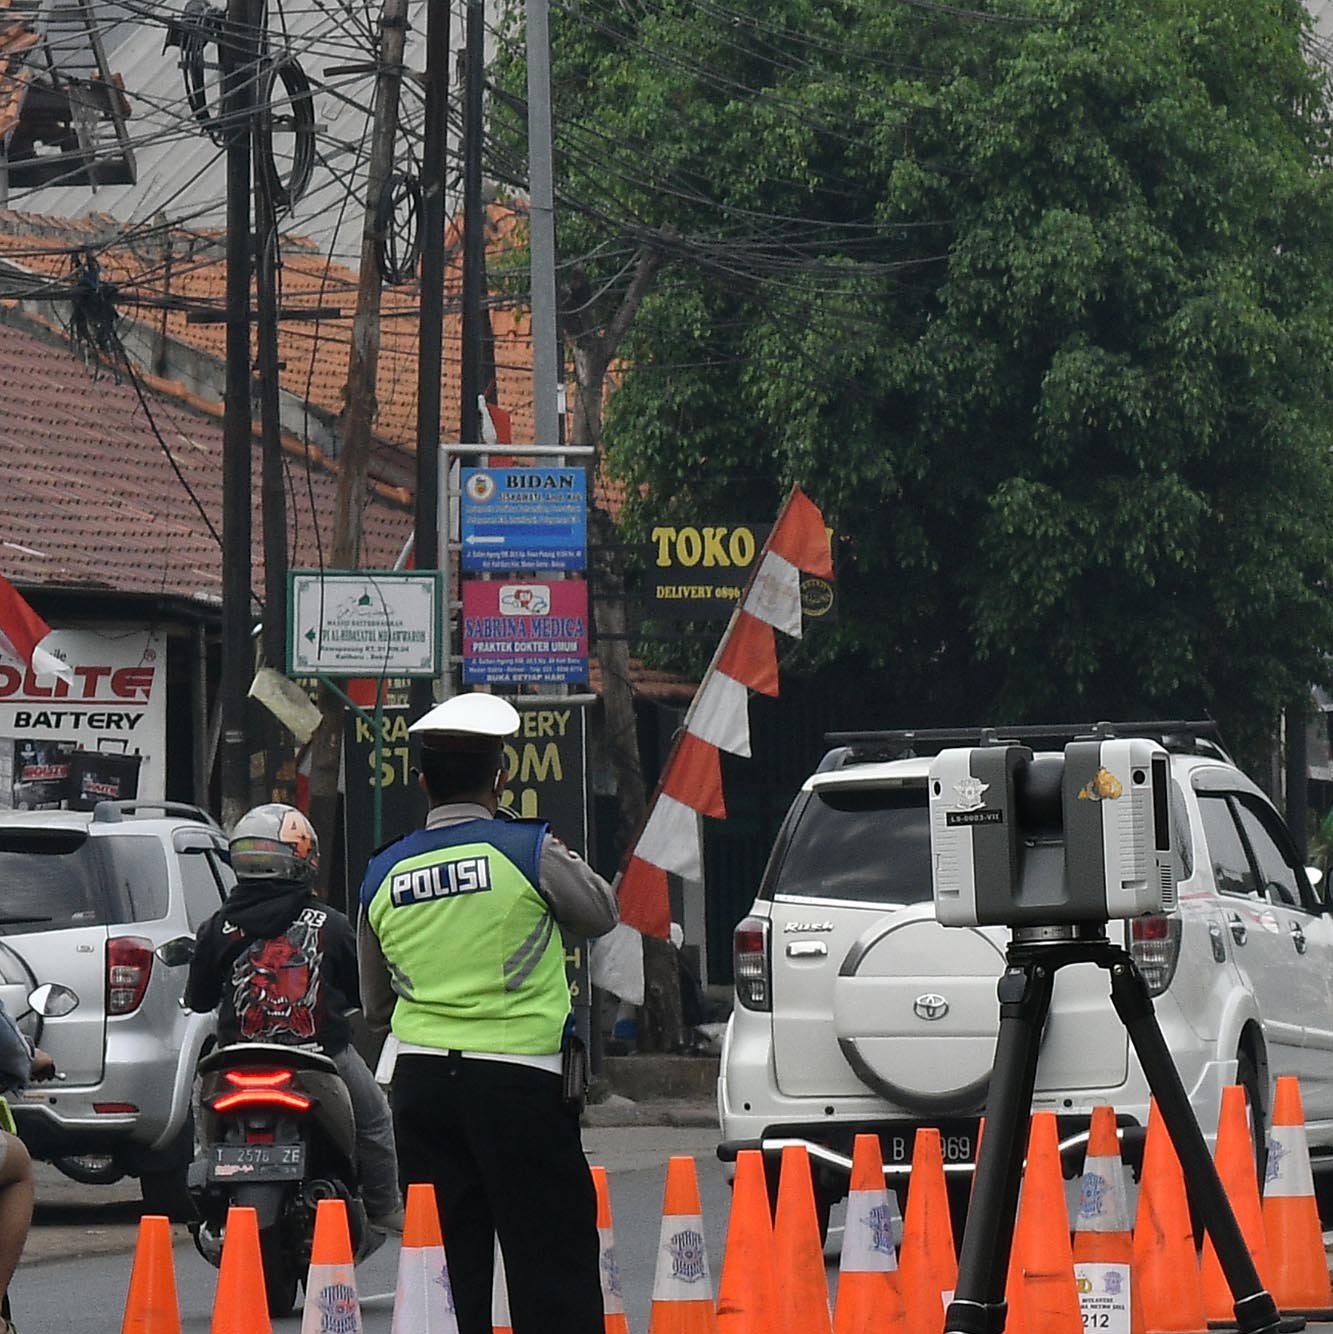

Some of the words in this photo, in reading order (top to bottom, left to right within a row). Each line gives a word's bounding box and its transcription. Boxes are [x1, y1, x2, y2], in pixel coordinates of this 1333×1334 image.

[506, 474, 575, 489] BIDAN
[652, 527, 756, 567] TOKO
[656, 585, 713, 599] DELIVERY
[715, 586, 741, 600] 0896
[465, 618, 527, 639] SABRINA
[532, 617, 585, 639] MEDICA
[472, 642, 513, 653] PRAKTEK
[514, 641, 550, 652] DOKTER
[551, 641, 578, 652] UMUM
[486, 674, 510, 682] BUKA
[512, 674, 543, 682] SETIAP
[544, 674, 566, 682] HARI
[14, 711, 144, 730] BATTERY
[392, 858, 488, 905] POLISI
[784, 920, 835, 934] Rush
[216, 1149, 225, 1162] T
[282, 1149, 301, 1163] ZE
[892, 1137, 905, 1161] B
[1081, 1313, 1110, 1328] 212
